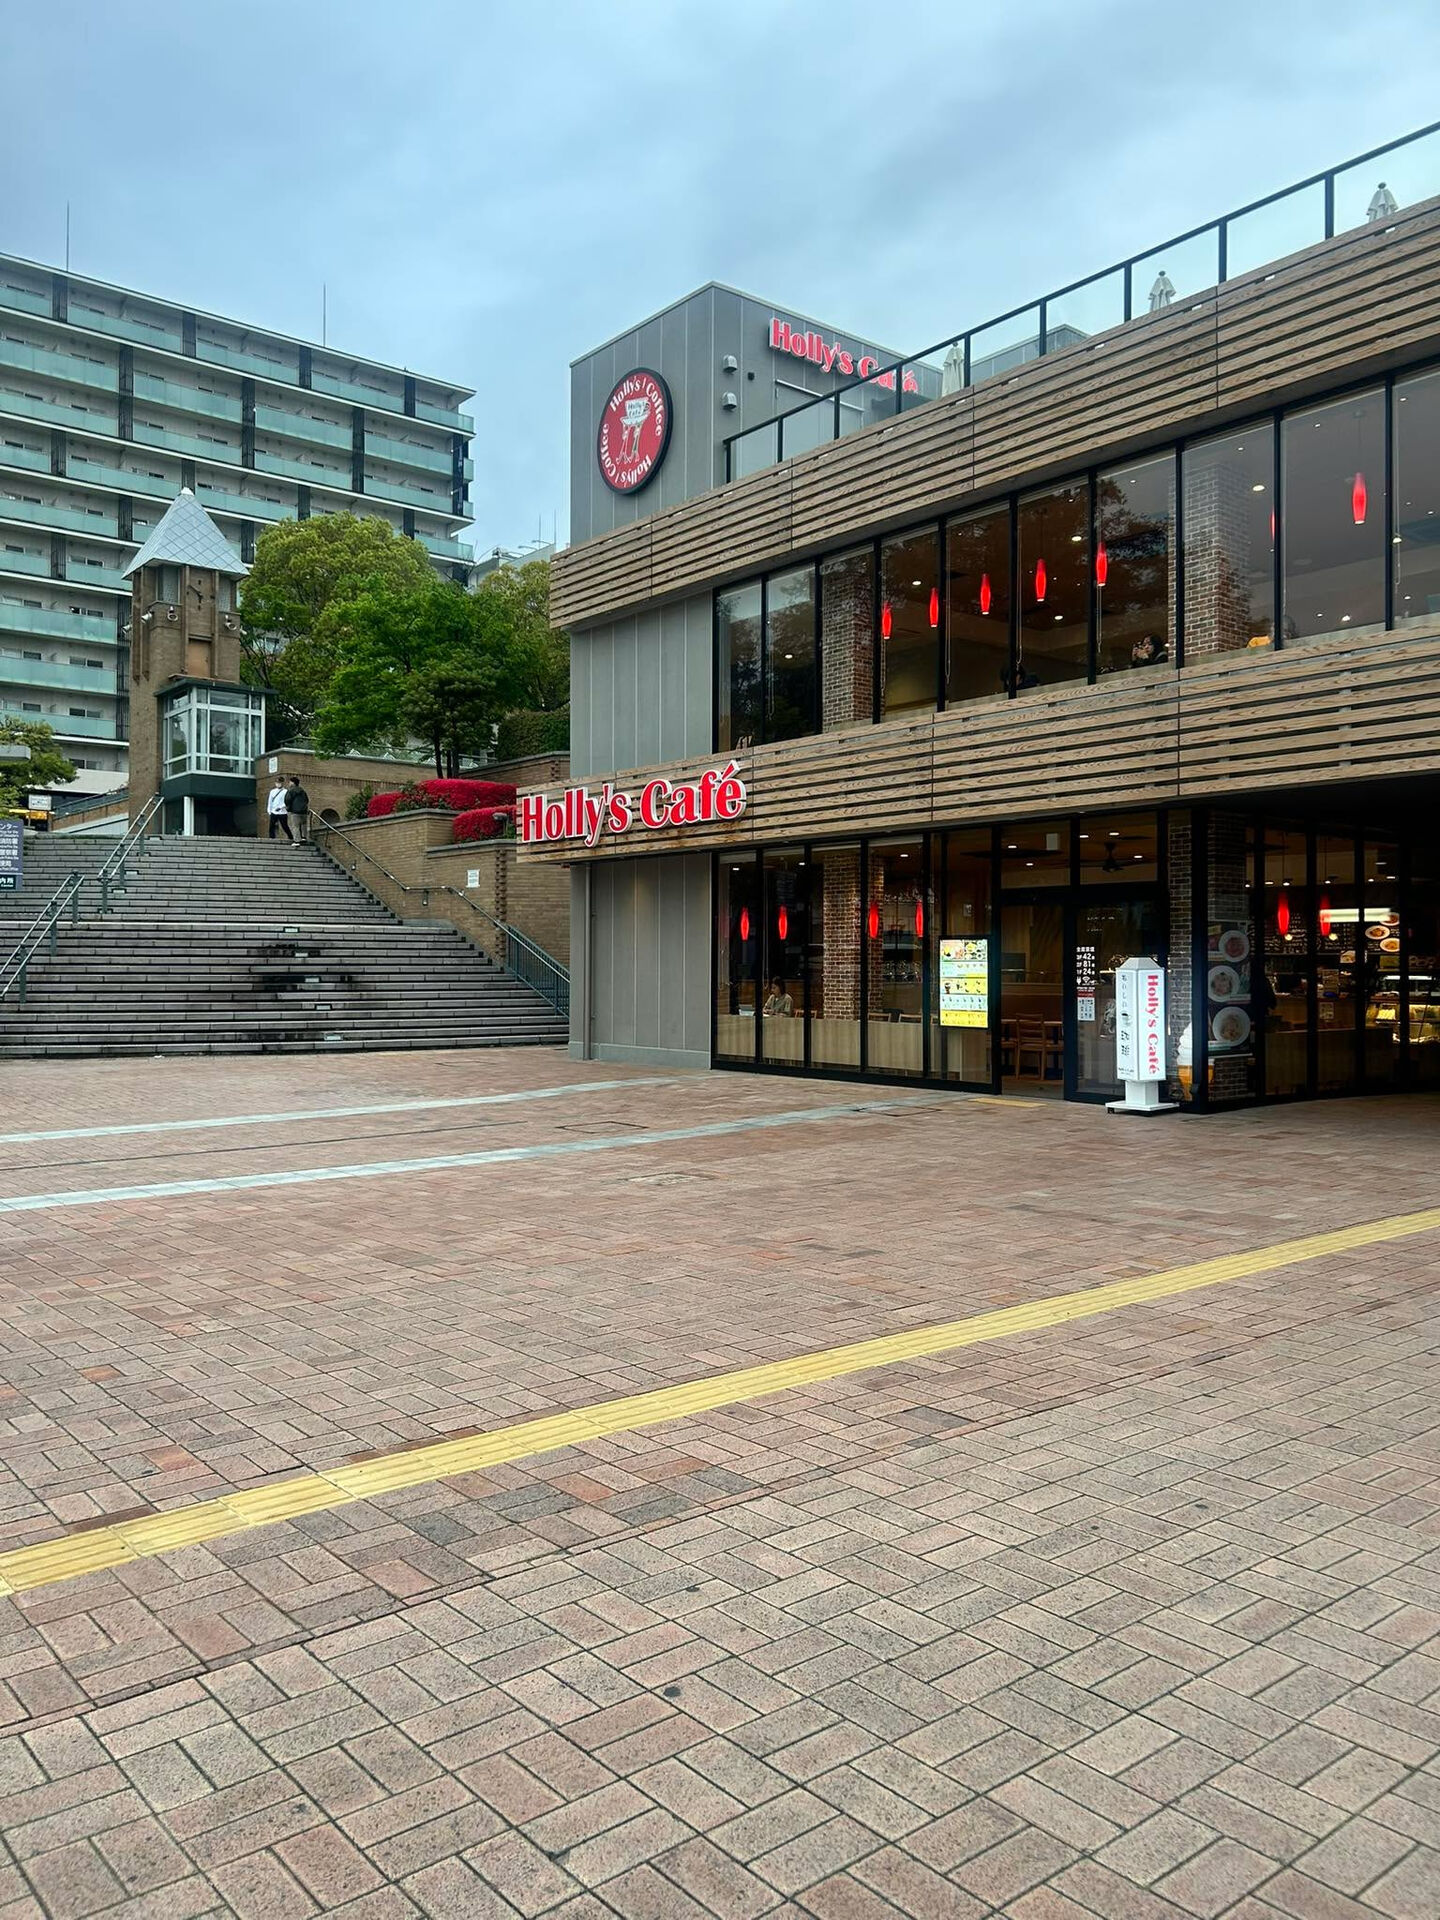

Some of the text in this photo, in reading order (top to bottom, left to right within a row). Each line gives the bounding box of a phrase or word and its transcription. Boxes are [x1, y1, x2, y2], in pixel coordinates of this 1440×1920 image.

[769, 317, 919, 394] Holly's Caé
[609, 375, 665, 437] Holly's Coffee
[600, 423, 653, 488] Holly's Coffee
[522, 760, 747, 848] Holly's Café
[1145, 975, 1160, 1075] Holly's Café
